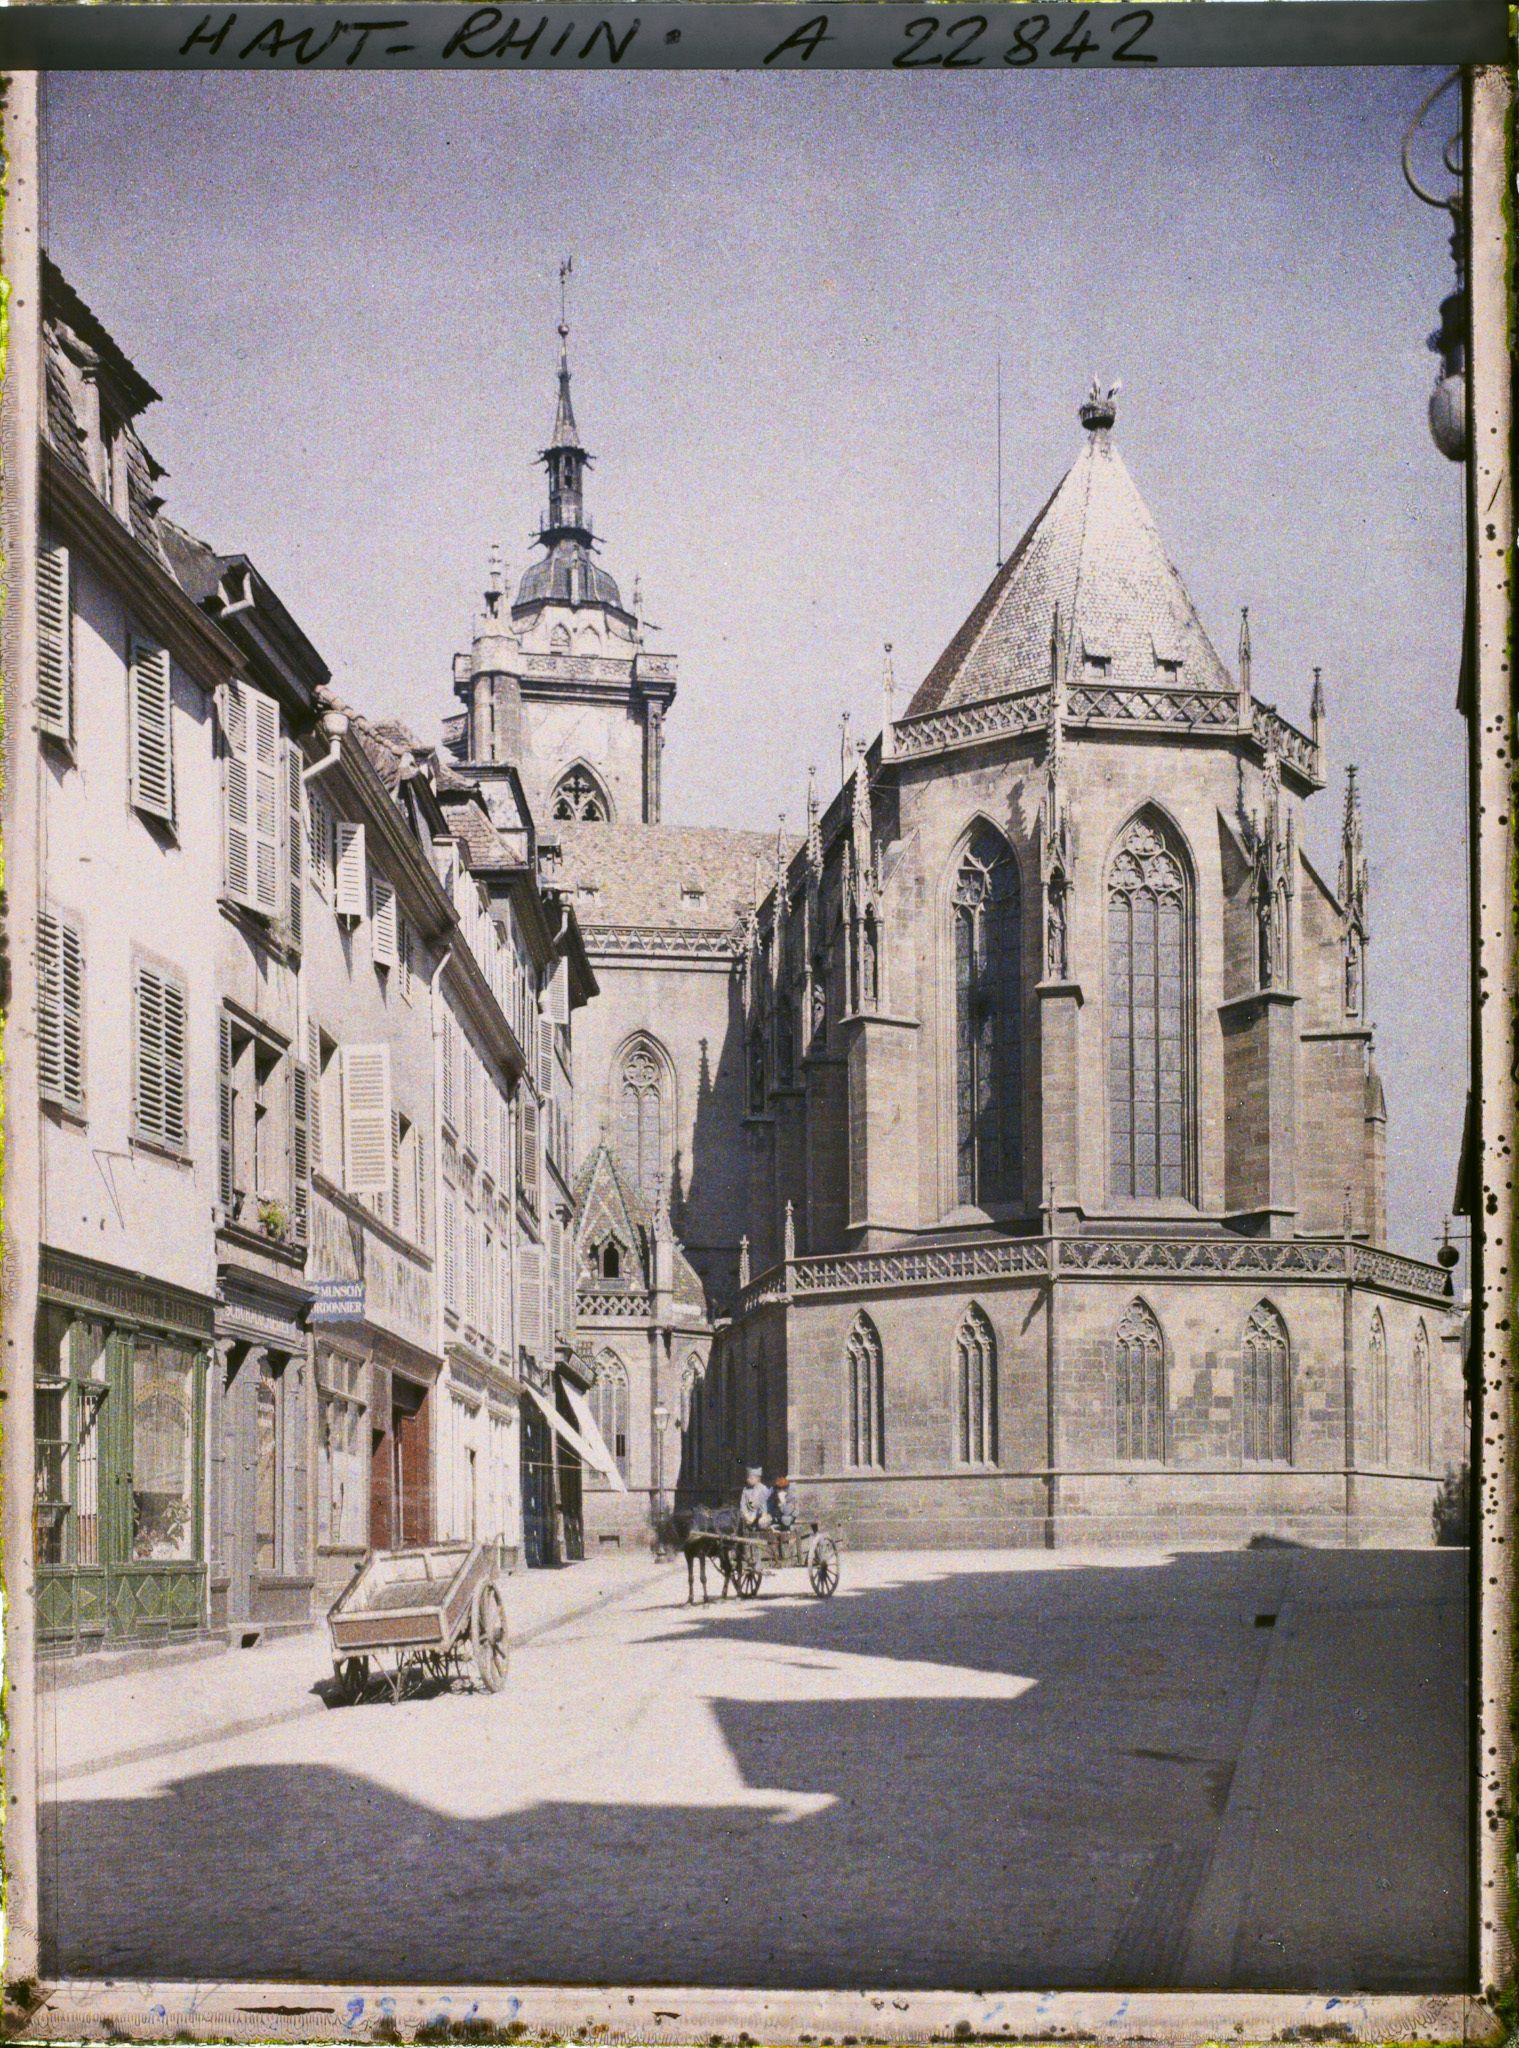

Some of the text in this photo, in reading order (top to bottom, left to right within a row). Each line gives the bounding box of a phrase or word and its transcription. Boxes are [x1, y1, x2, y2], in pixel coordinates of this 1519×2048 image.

[762, 15, 836, 65] A
[892, 9, 1159, 68] 22842
[310, 1301, 362, 1314] ORDONNIER
